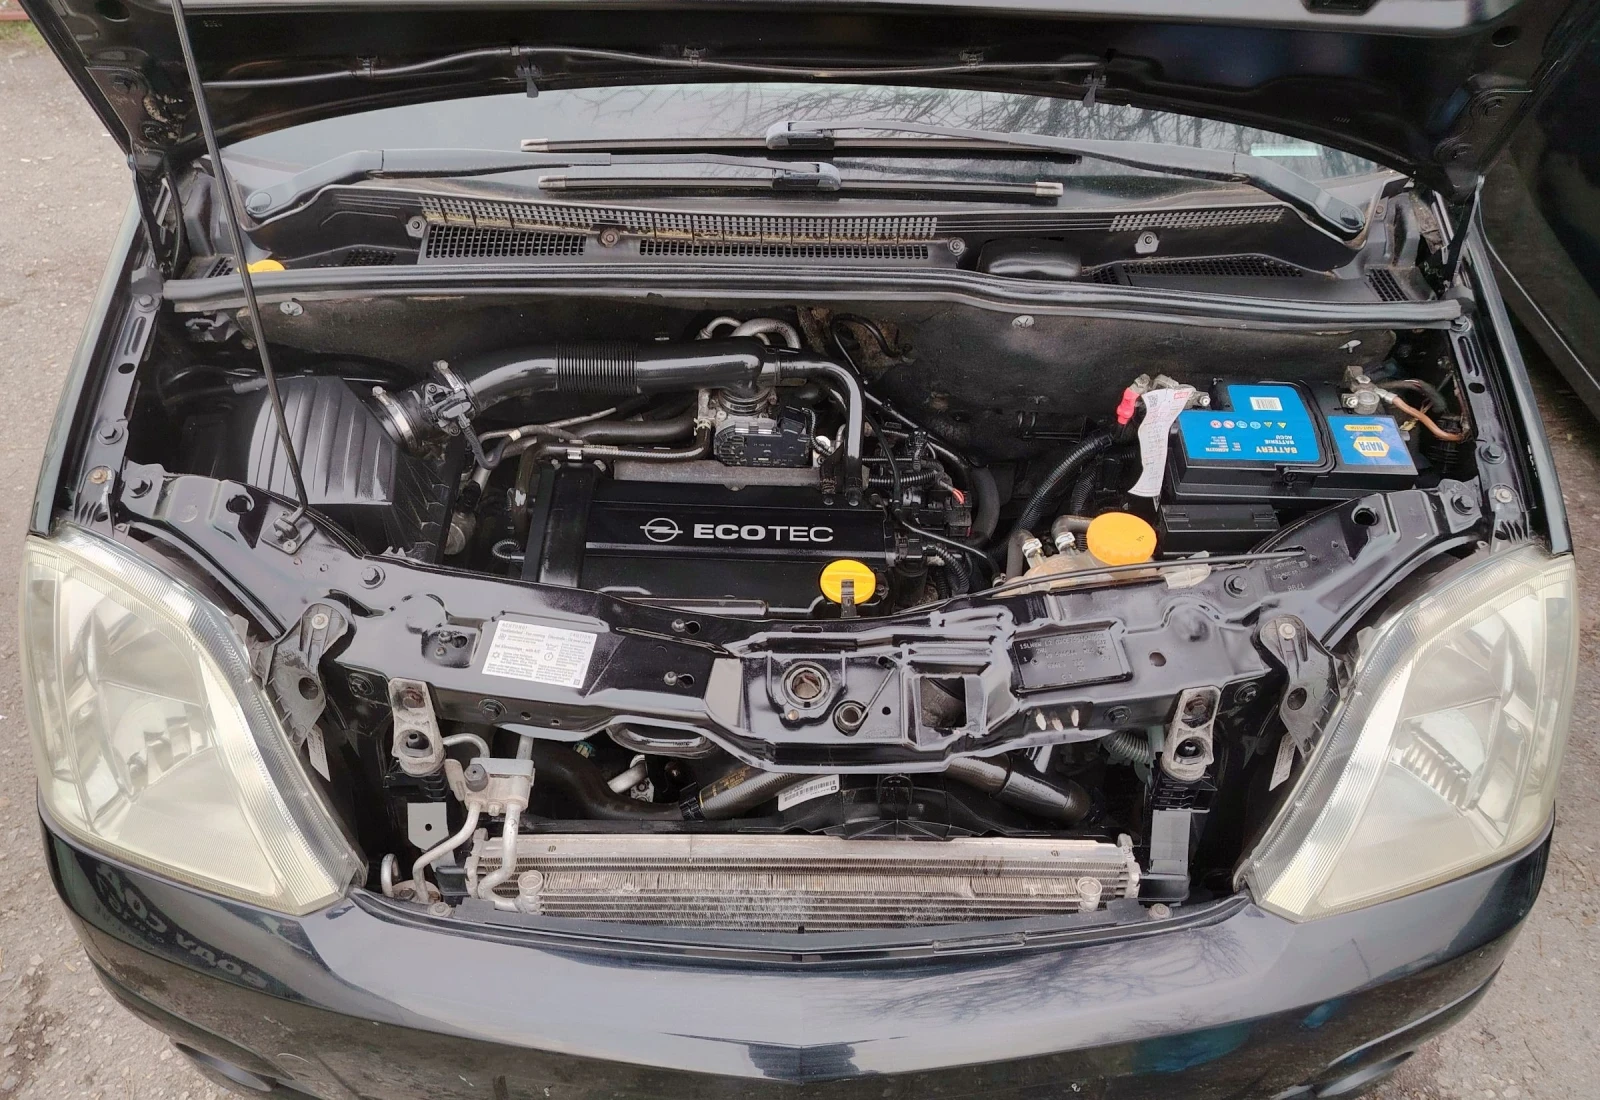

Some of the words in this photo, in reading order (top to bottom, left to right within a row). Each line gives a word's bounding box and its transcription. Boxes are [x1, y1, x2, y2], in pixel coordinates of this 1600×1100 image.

[1255, 445, 1298, 454] BATTERY
[1358, 441, 1384, 452] NAPA
[693, 523, 834, 543] ECOTEC
